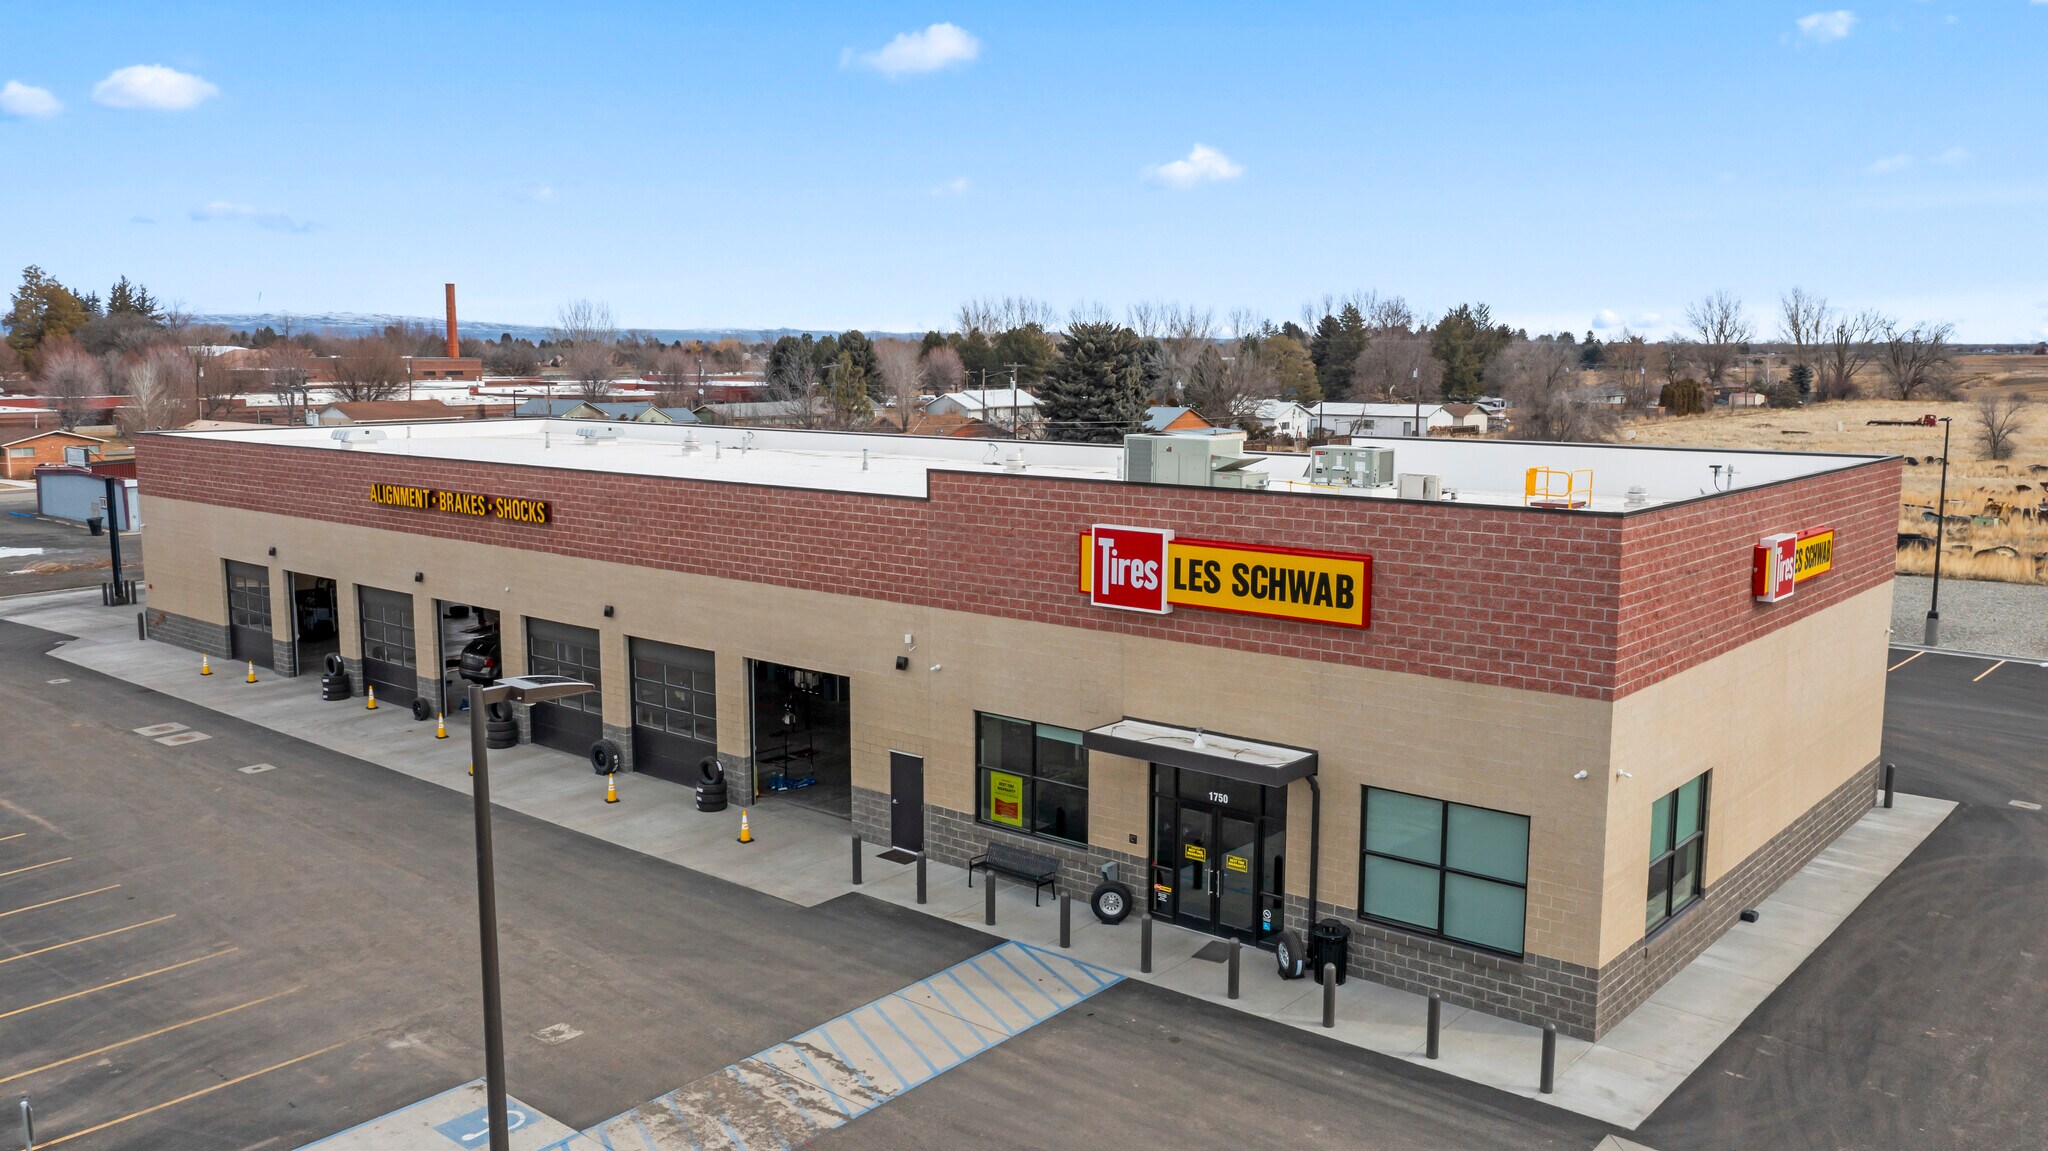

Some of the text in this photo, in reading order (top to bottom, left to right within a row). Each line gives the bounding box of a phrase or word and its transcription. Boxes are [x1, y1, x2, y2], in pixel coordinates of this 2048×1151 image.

[370, 483, 546, 523] ALIGNMENT BRAKES SHOCKS
[1098, 537, 1159, 595] Tires
[1776, 546, 1794, 593] Tires
[1795, 539, 1831, 573] ES SCHWAB
[1173, 557, 1354, 609] LES SCHWAB
[1208, 791, 1229, 804] 1750
